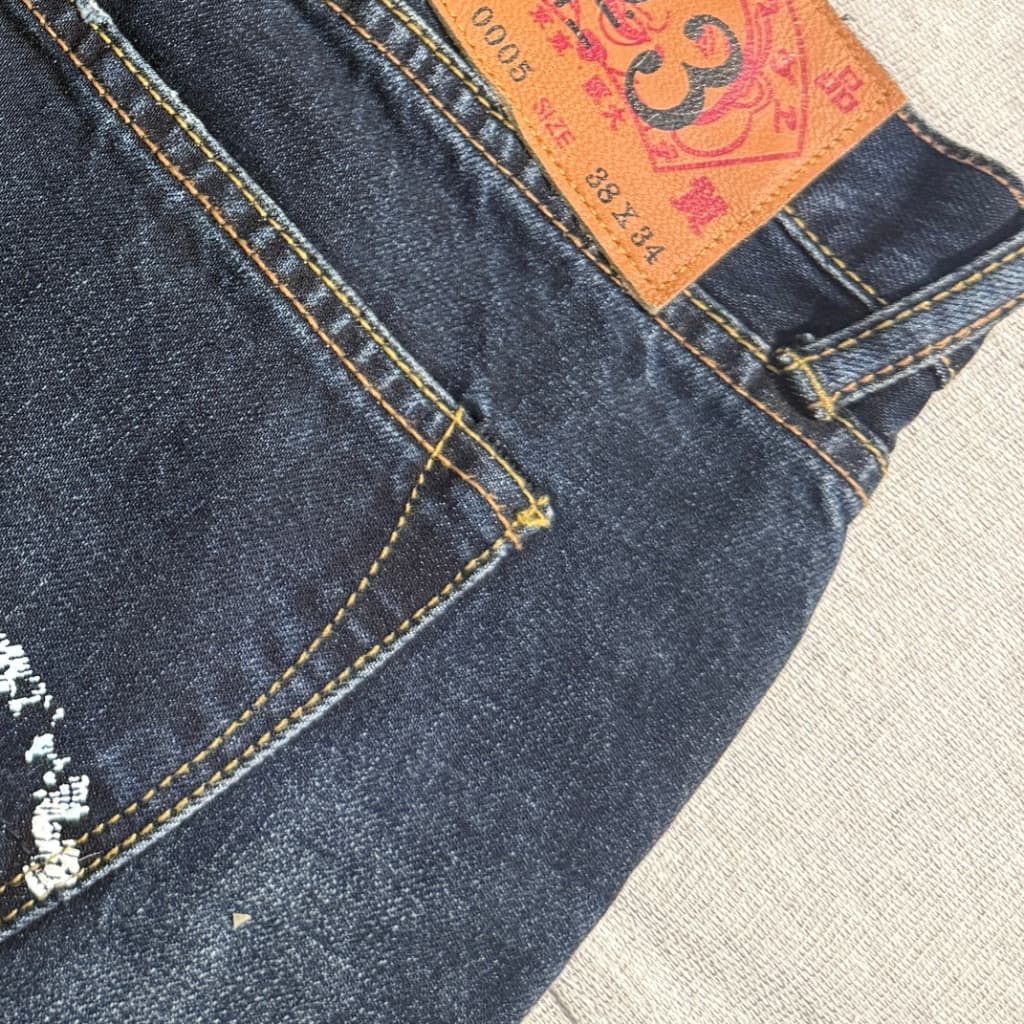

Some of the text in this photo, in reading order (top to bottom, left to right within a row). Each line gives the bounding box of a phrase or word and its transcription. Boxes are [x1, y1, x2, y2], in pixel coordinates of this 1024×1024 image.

[472, 6, 534, 83] 0005
[533, 97, 577, 149] SIZE
[625, 14, 743, 131] 3
[815, 64, 864, 114] 品
